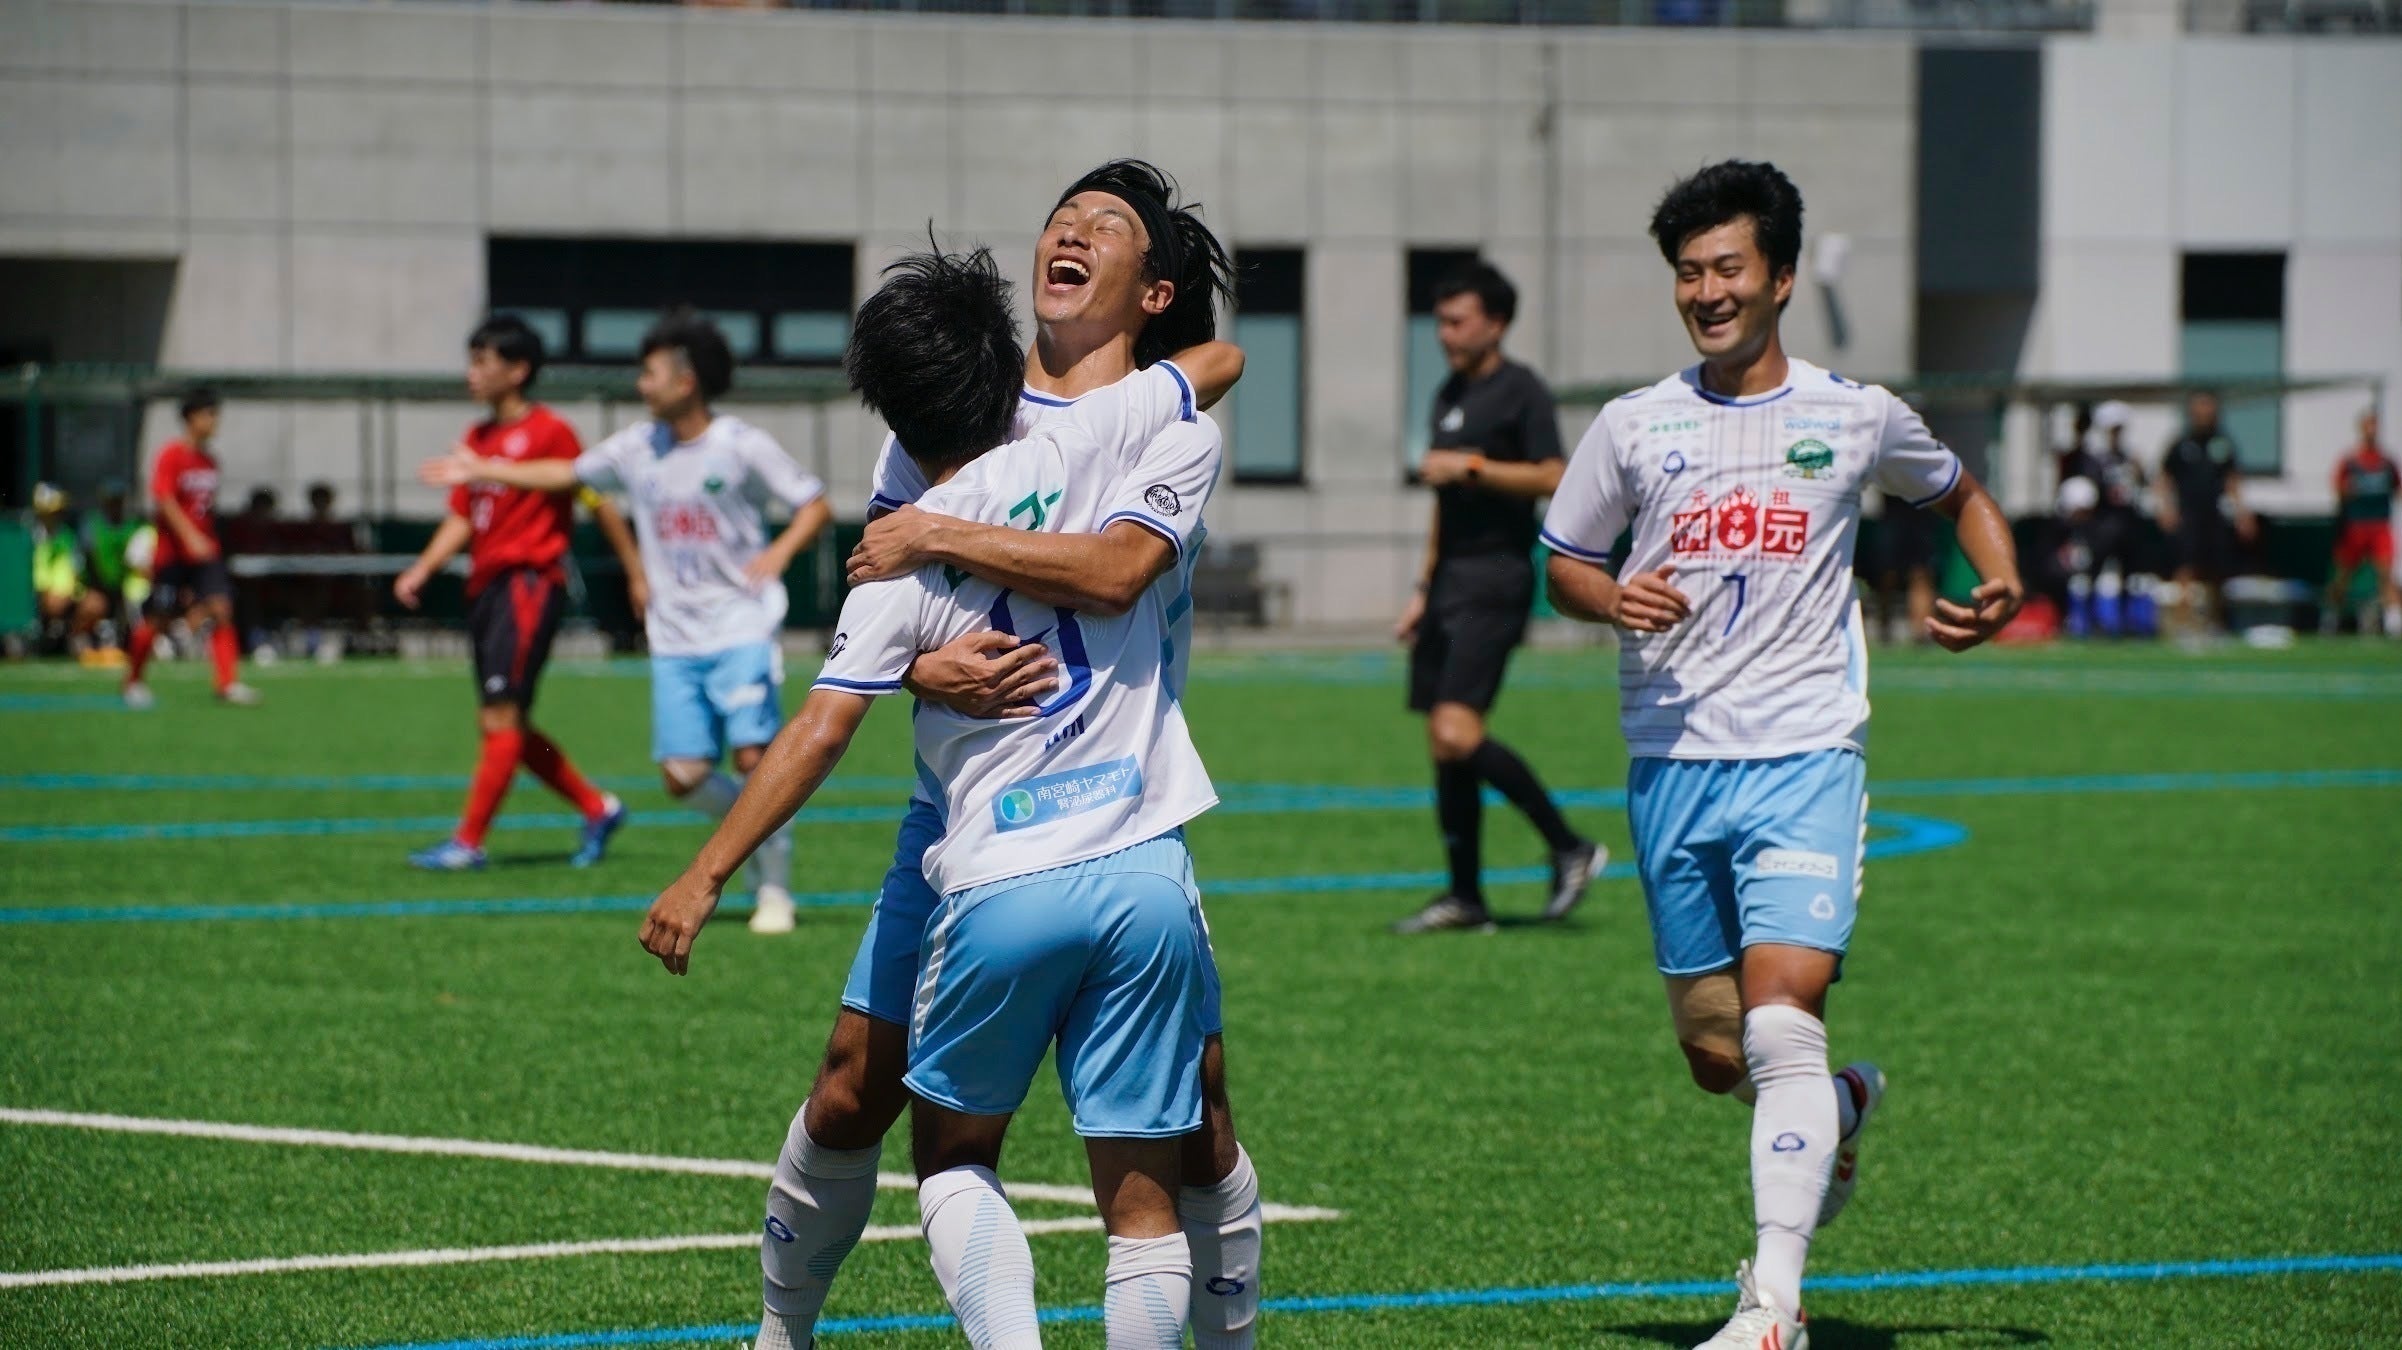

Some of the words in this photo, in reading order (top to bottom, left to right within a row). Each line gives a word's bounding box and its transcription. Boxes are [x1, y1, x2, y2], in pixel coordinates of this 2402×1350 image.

[1721, 573, 1746, 637] 7
[1036, 767, 1130, 801] 南宮崎ヤマモト
